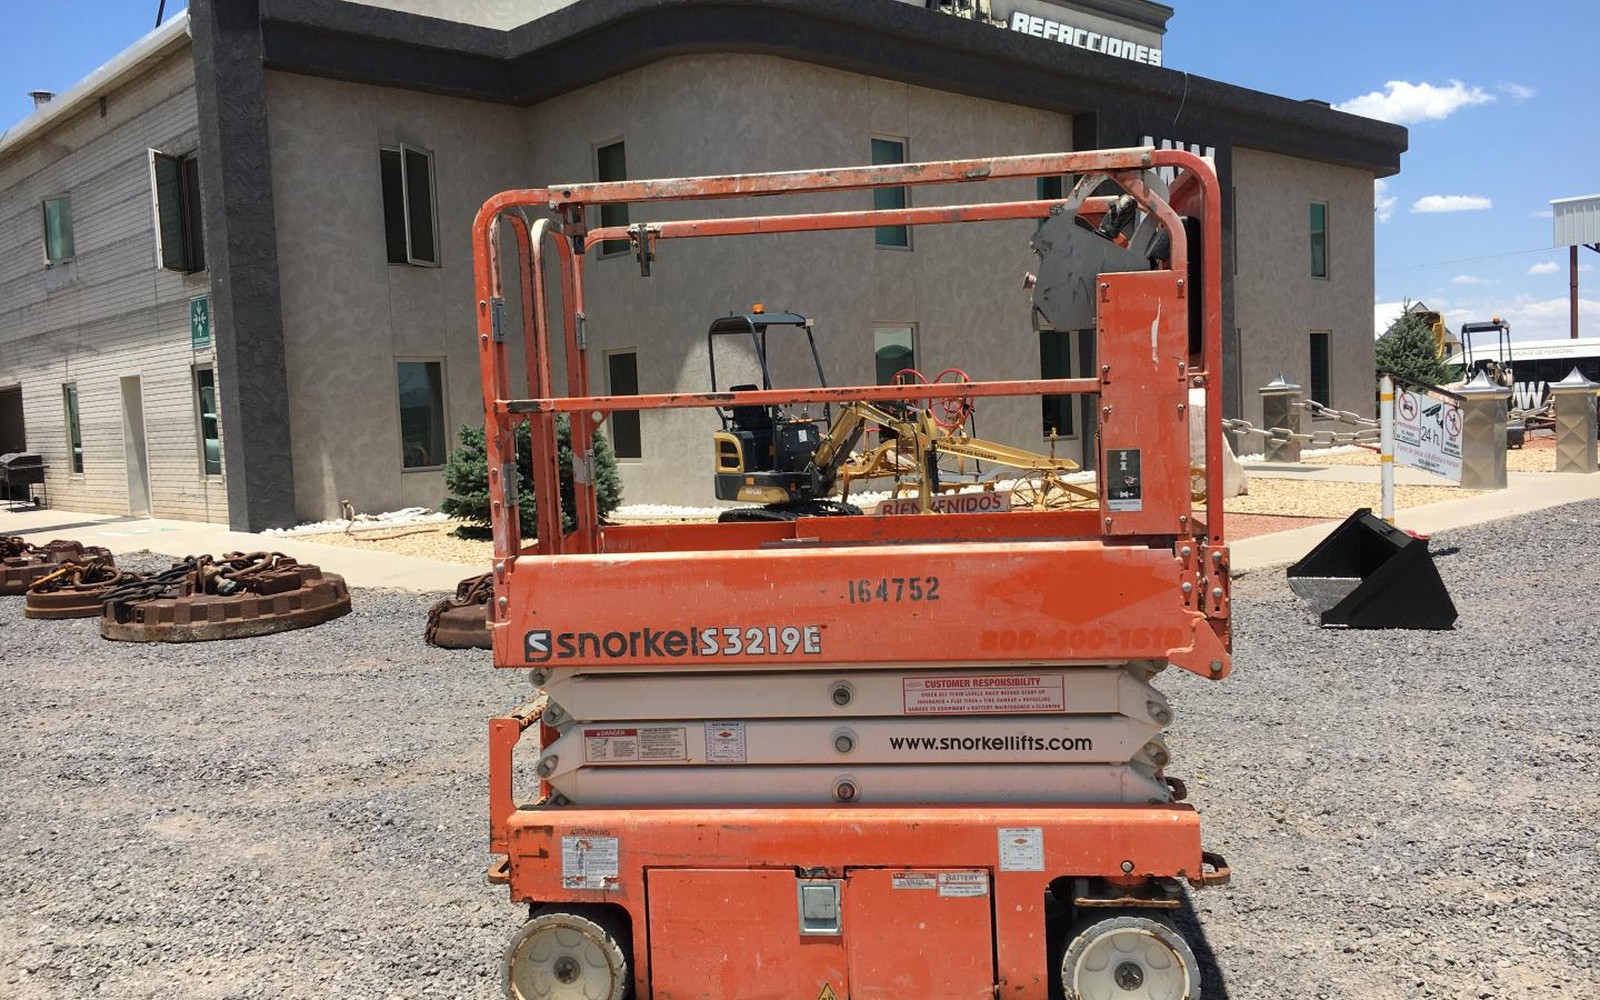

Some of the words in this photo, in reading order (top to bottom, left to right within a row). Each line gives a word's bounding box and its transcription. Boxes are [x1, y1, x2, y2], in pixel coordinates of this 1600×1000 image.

[1011, 11, 1162, 67] REFACCIONES
[1421, 426, 1431, 442] 24
[848, 576, 940, 603] 164752
[557, 627, 698, 658] snorkel
[700, 625, 821, 656] S3219E
[924, 679, 971, 689] CUSTOMER
[972, 677, 1041, 688] RESPONSIBILITY
[889, 735, 1093, 751] www.snorkellifts.com
